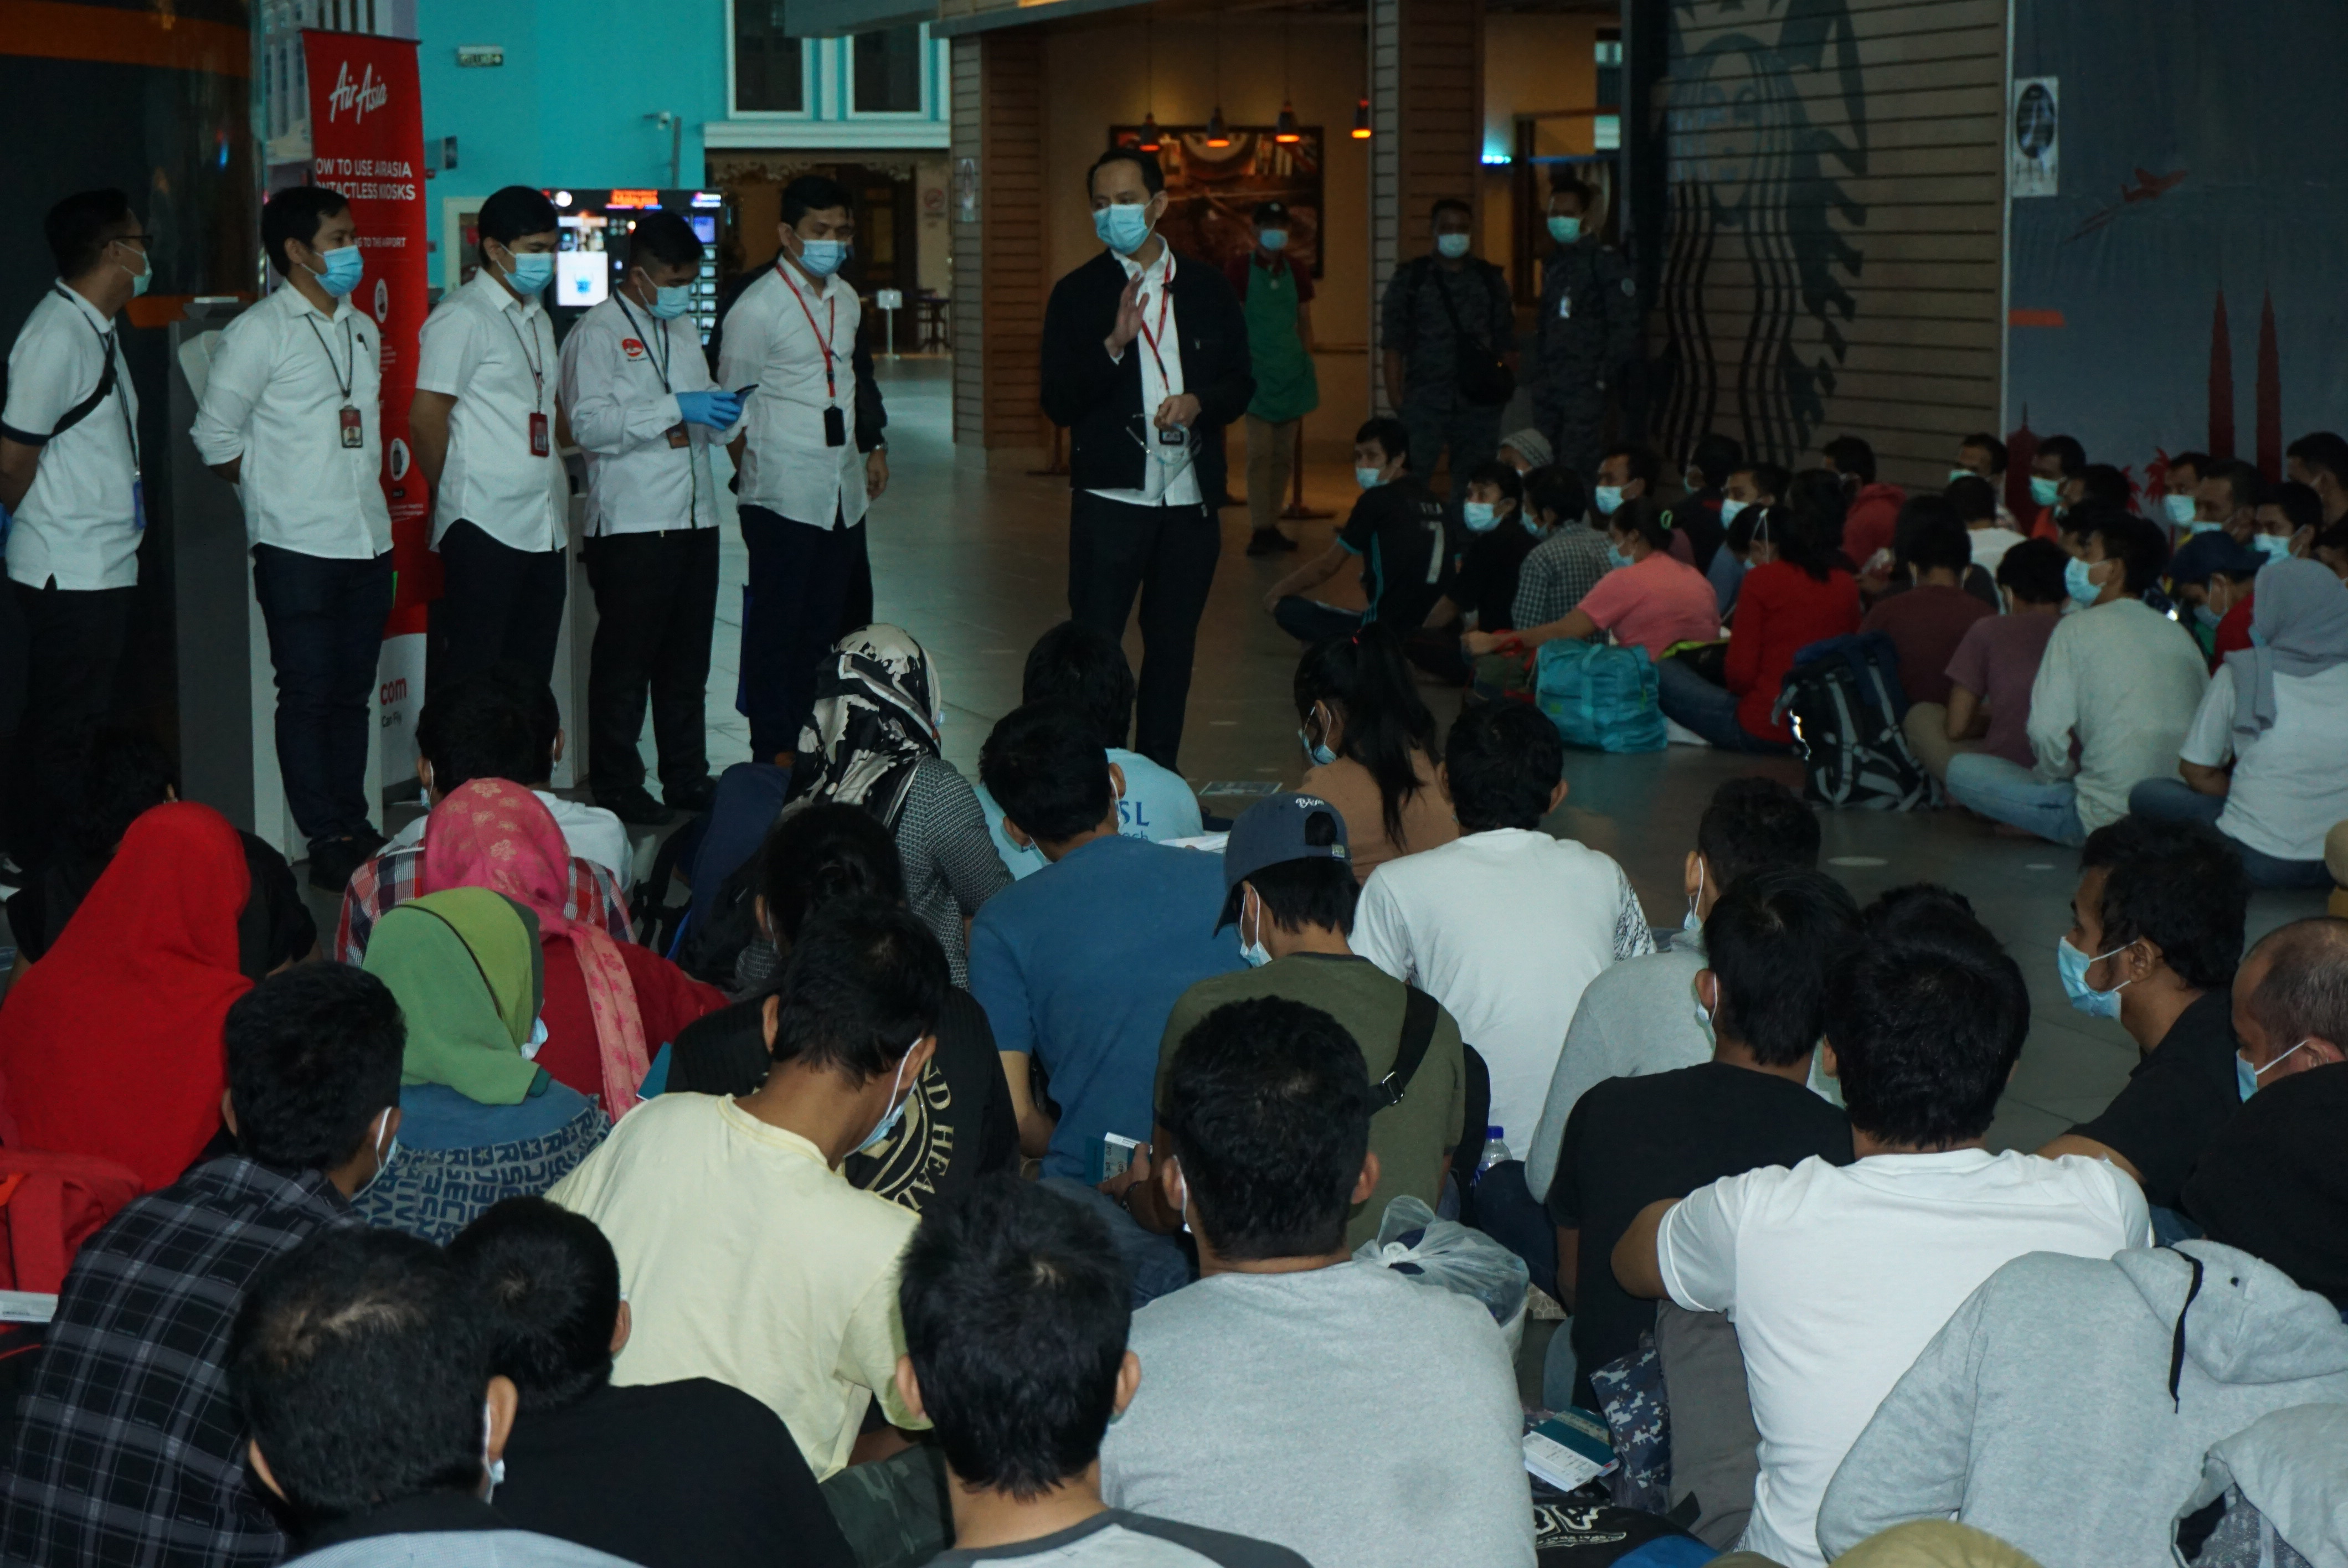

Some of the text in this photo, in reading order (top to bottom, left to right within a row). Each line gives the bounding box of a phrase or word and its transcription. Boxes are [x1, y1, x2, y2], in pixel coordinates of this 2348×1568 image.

[316, 158, 334, 174] OW
[337, 158, 352, 176] TO
[354, 159, 373, 176] USE
